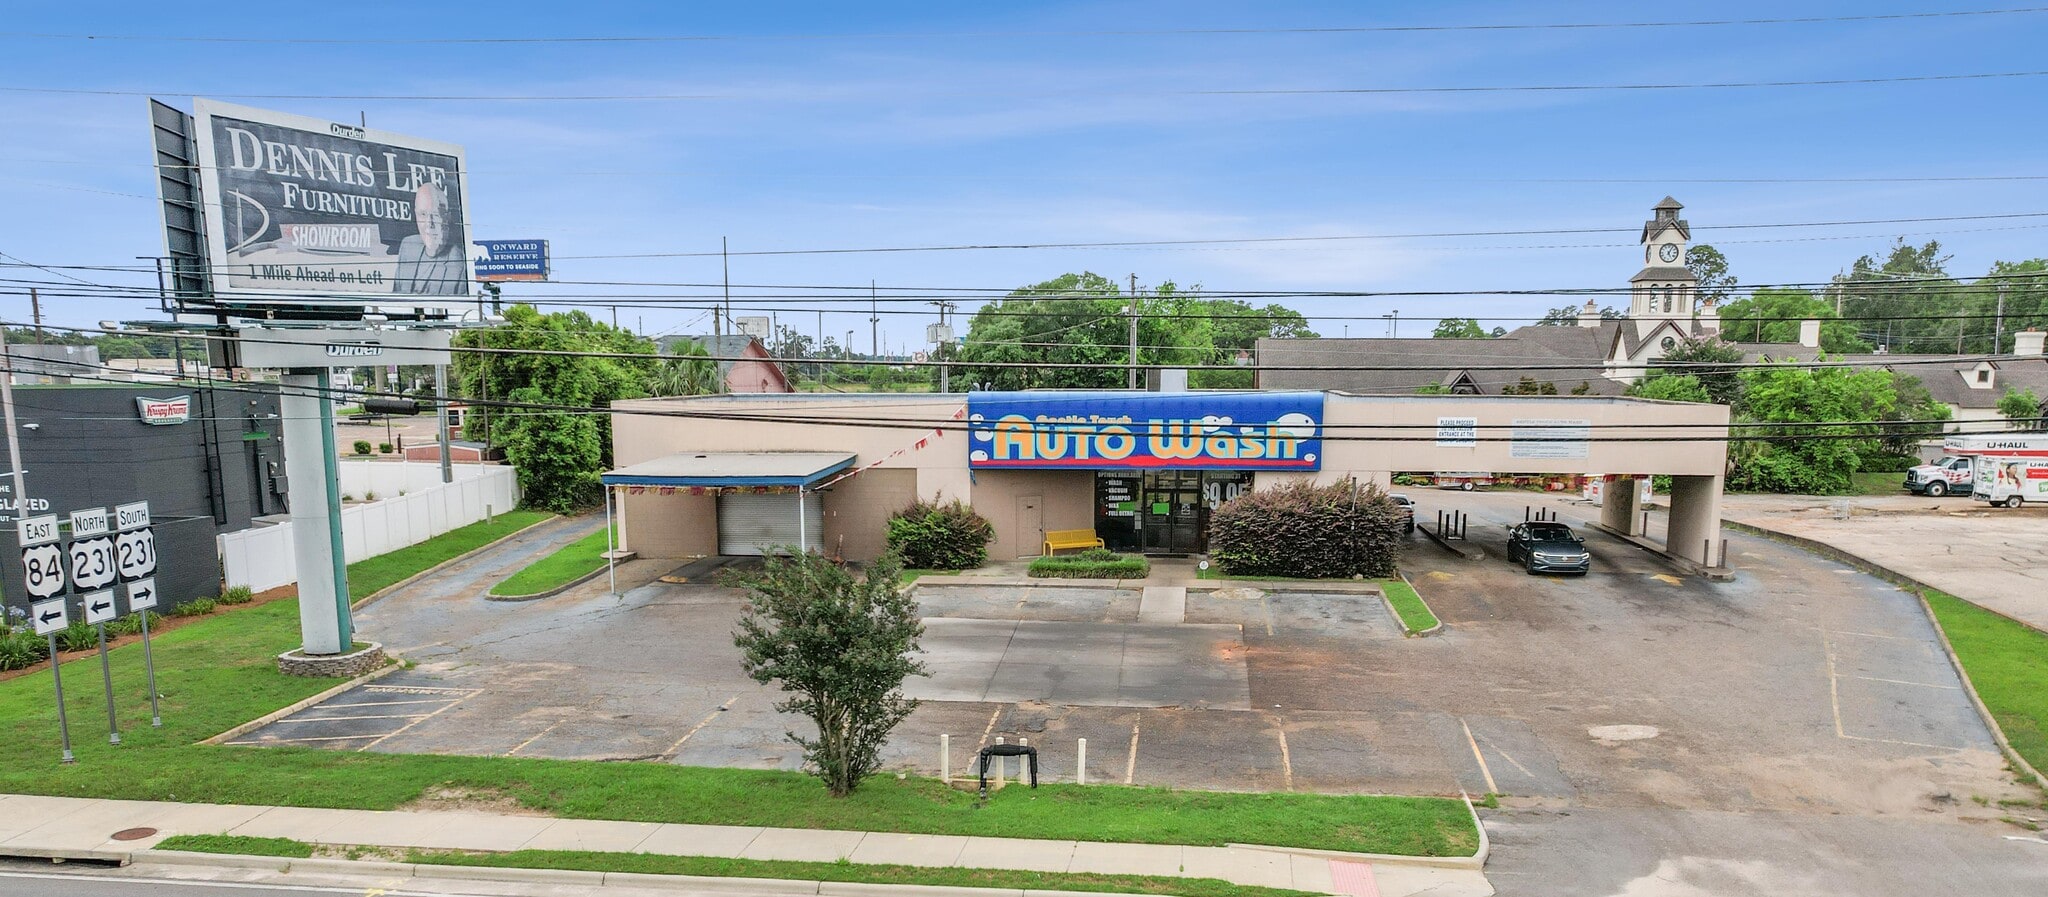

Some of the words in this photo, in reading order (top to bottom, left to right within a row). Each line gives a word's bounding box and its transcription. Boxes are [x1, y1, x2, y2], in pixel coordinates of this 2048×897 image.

[332, 124, 365, 139] Durden
[225, 127, 375, 187] DENNIS
[383, 152, 448, 196] LEE
[281, 182, 412, 221] FURNITURE
[291, 225, 371, 248] SHOWROOM
[493, 243, 538, 251] ONWARD
[249, 263, 258, 280] 1
[262, 264, 292, 281] Mile
[296, 266, 334, 283] Ahead
[339, 271, 355, 283] on
[358, 269, 383, 285] Left
[1148, 418, 1299, 460] Wash
[74, 515, 105, 532] NORTH
[120, 509, 147, 526] SOUTH
[26, 523, 51, 540] EAST
[75, 546, 114, 579] 231
[120, 537, 154, 569] 231
[28, 554, 60, 586] 84
